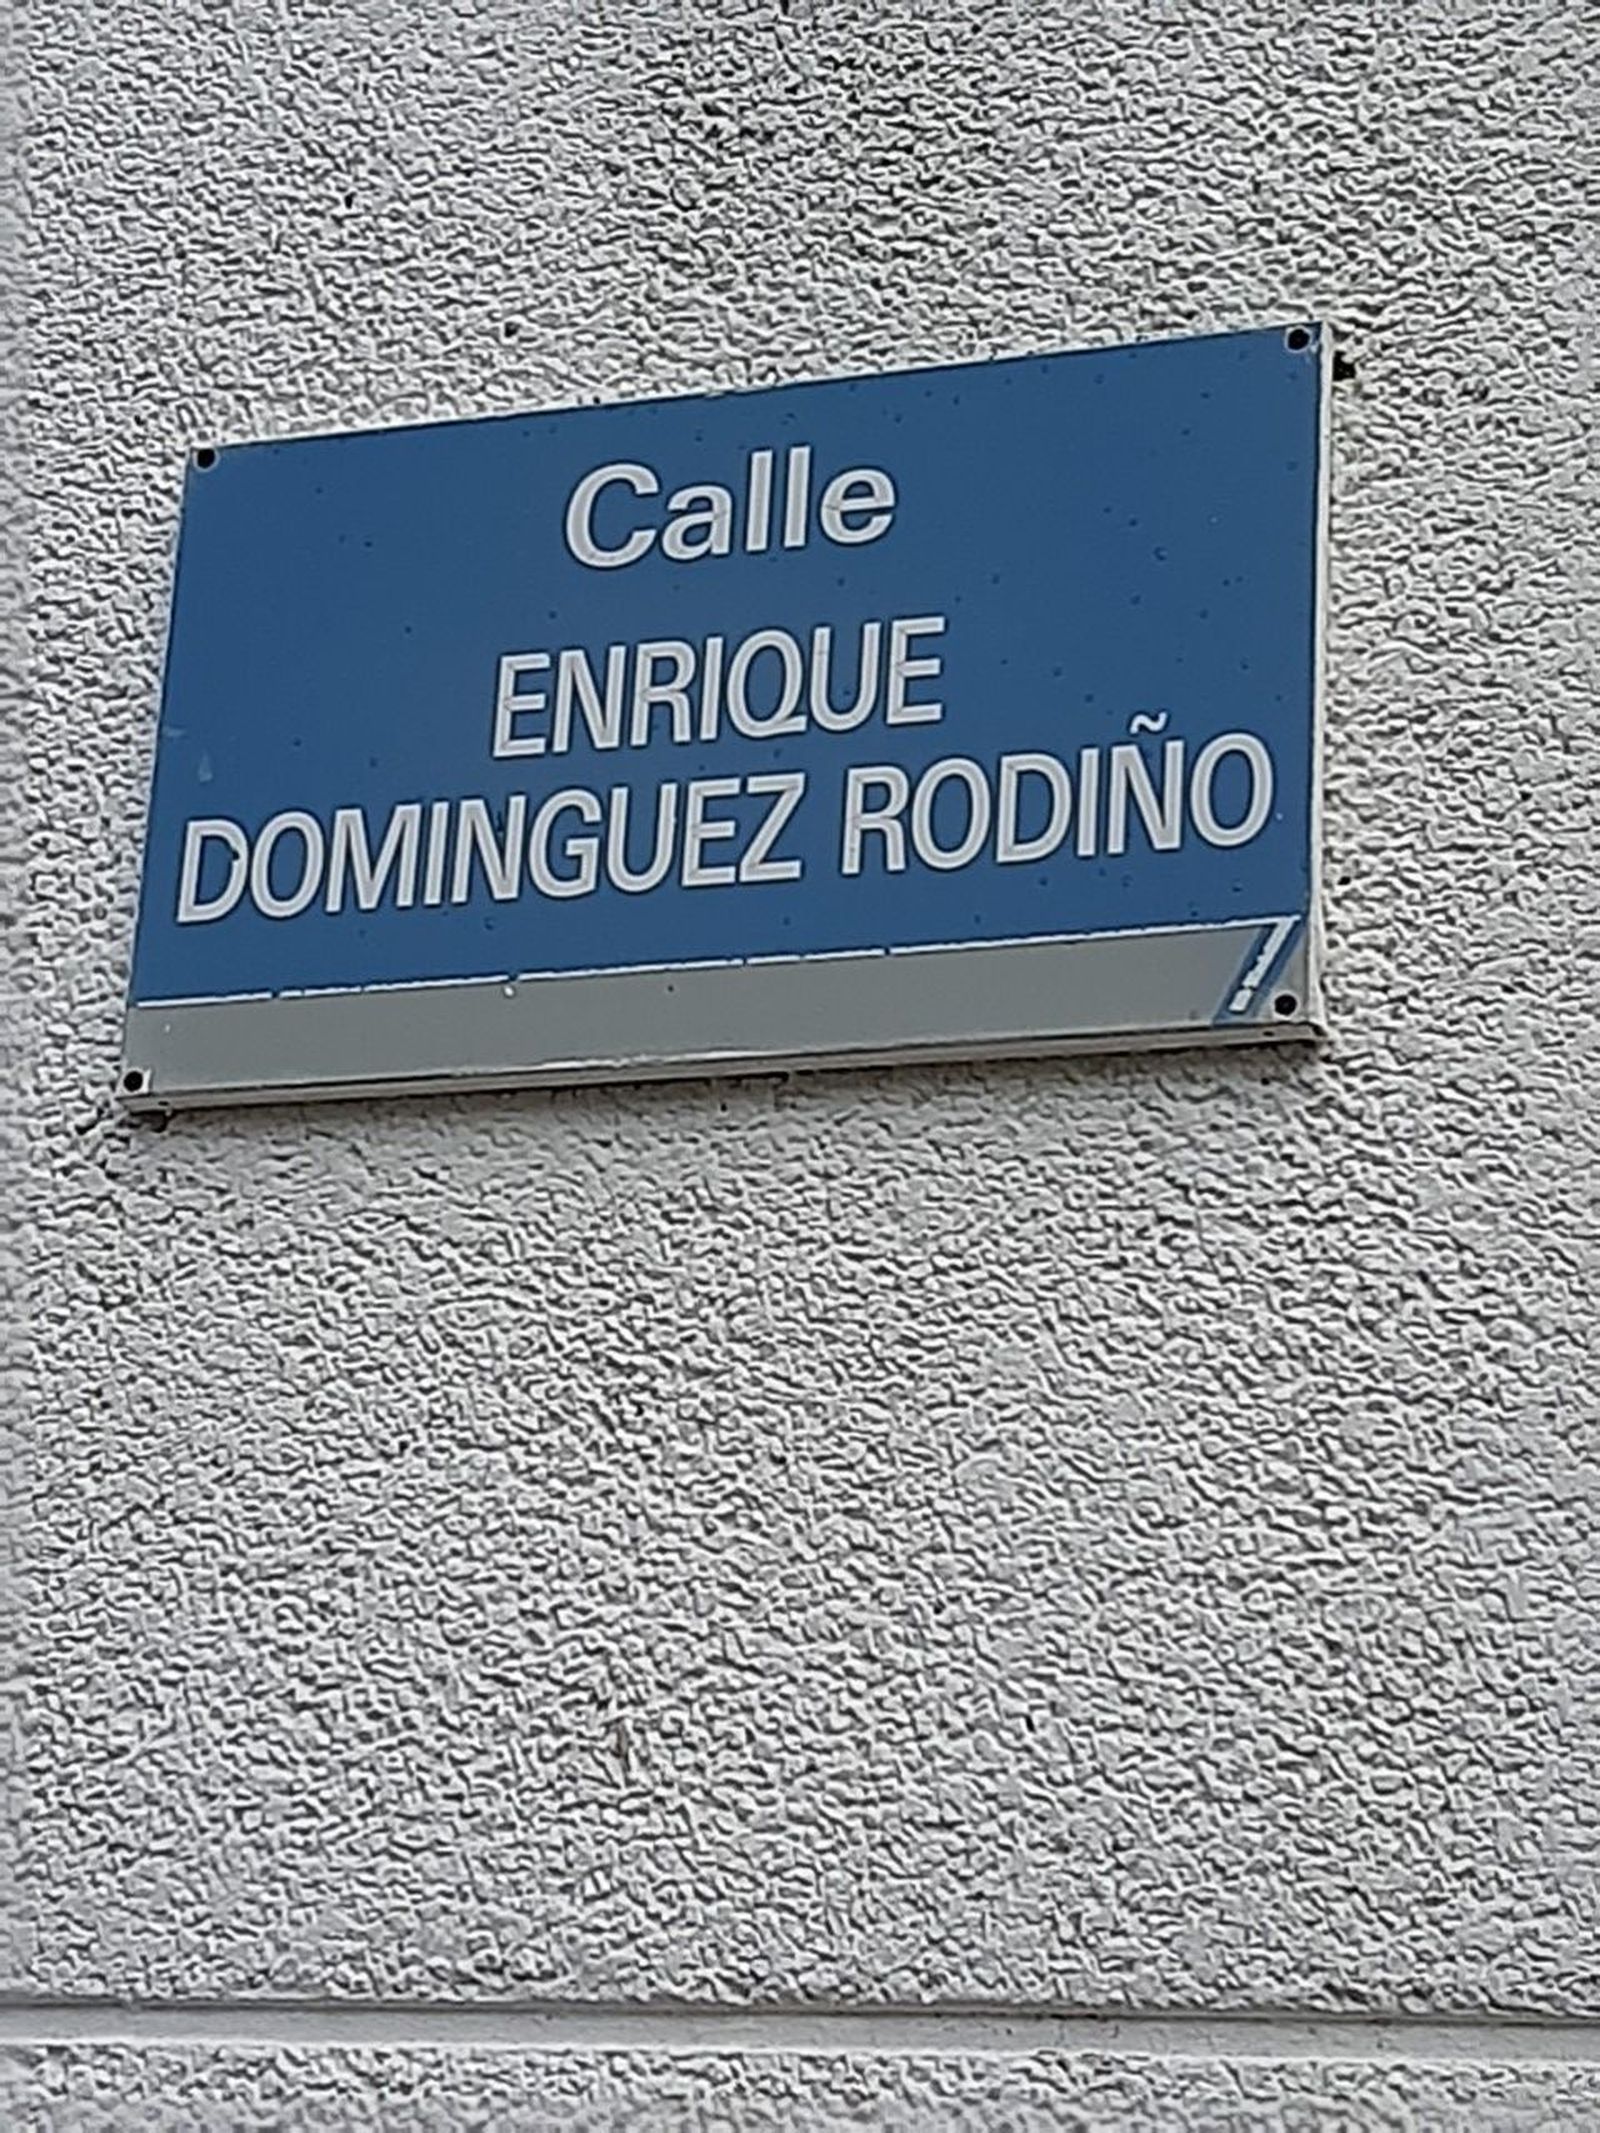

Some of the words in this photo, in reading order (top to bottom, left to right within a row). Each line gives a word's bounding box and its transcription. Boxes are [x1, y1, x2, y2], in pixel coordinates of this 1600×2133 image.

[566, 446, 895, 567] Calle
[493, 616, 945, 757] ENRIQUE
[177, 772, 805, 922] DOMINGUEZ
[842, 712, 1273, 874] RODIÑO
